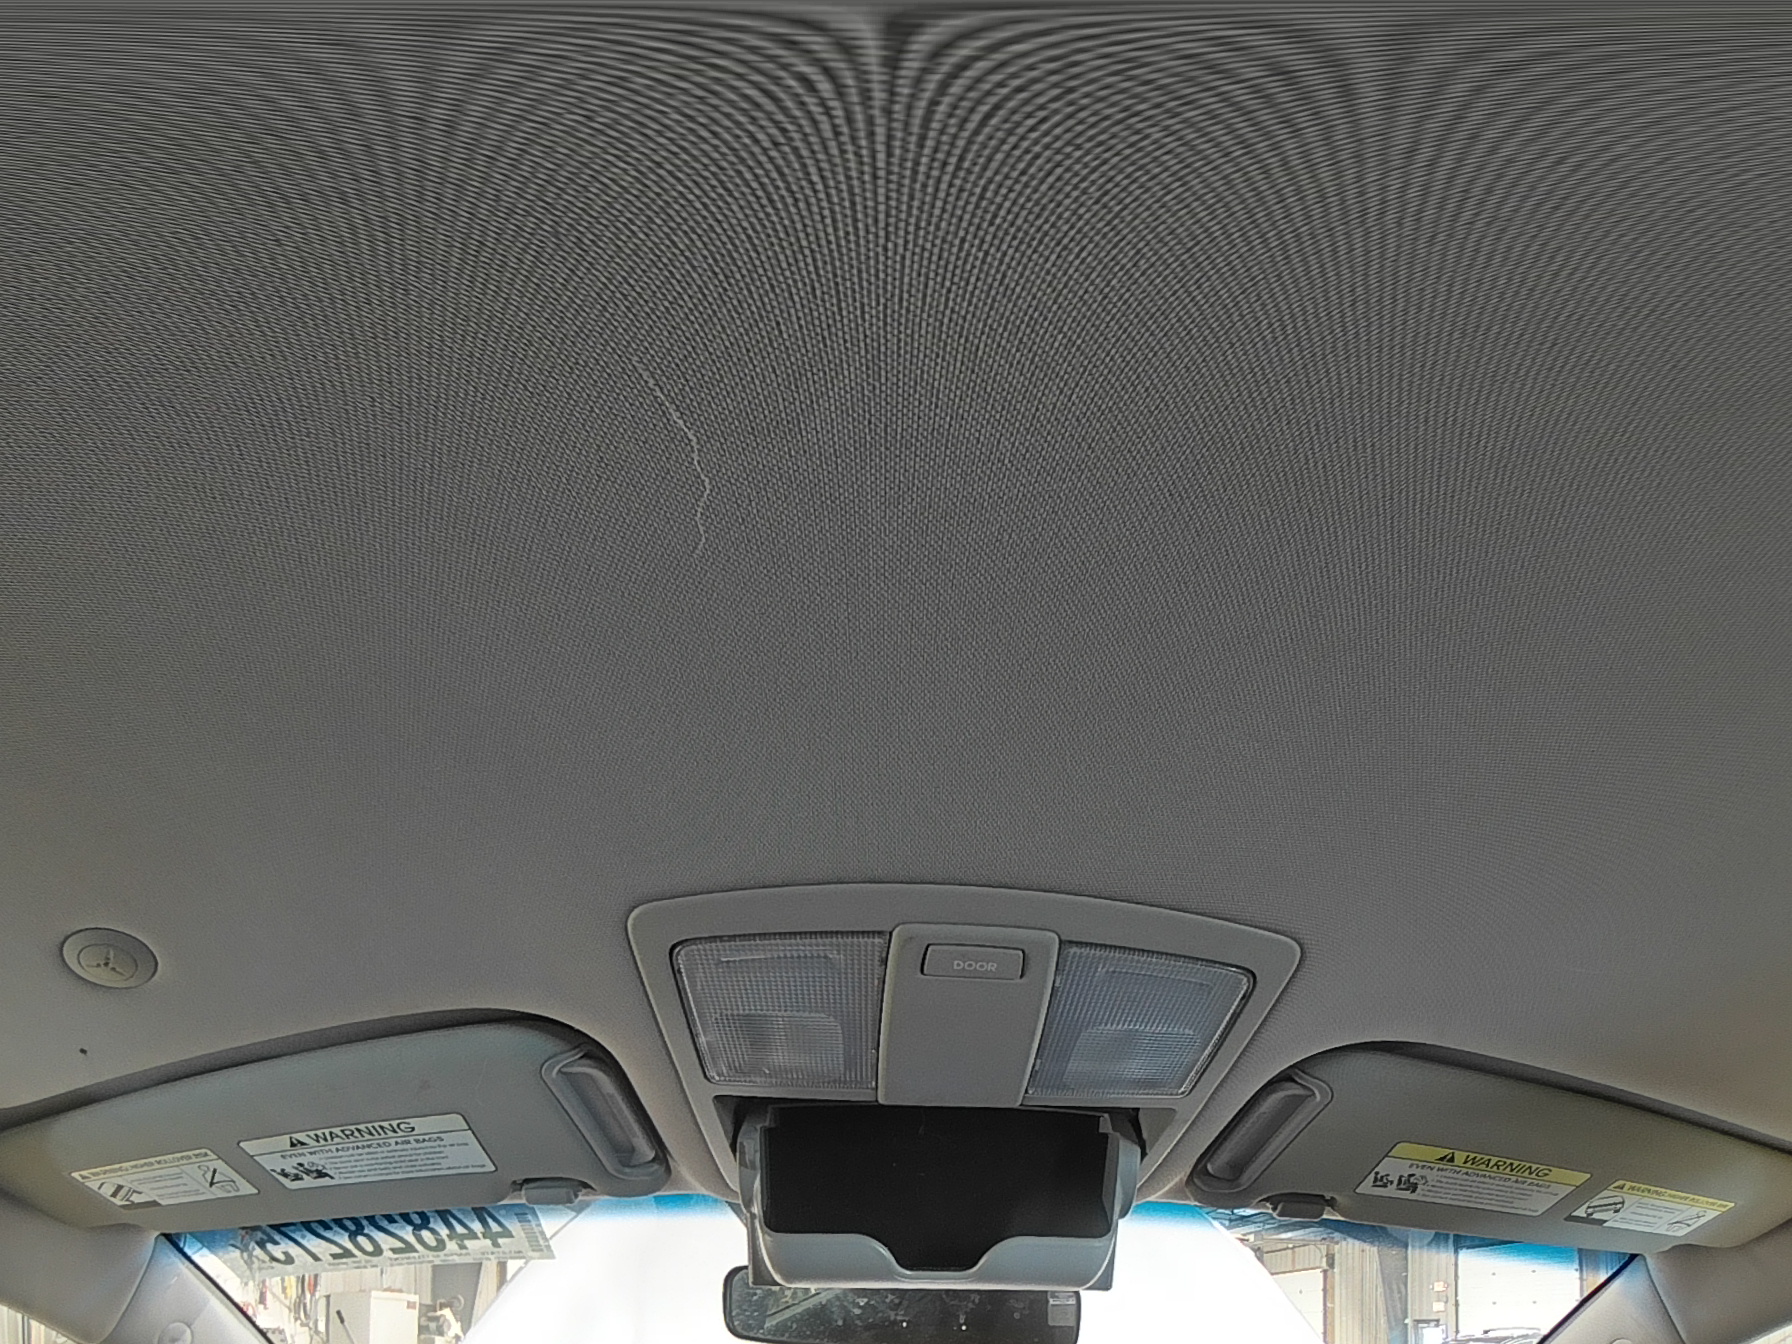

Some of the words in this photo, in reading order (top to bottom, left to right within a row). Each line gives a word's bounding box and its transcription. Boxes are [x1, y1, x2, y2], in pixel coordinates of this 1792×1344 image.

[953, 960, 997, 972] DOOR
[306, 1121, 416, 1144] WARNING
[334, 1141, 392, 1153] ADVANCED
[394, 1139, 412, 1147] AIR
[413, 1135, 444, 1144] BAGS
[1408, 1163, 1436, 1172] EVEN
[1436, 1167, 1462, 1175] WITH
[1461, 1170, 1511, 1183] ADVANCED
[1511, 1177, 1527, 1186] AIR
[1462, 1154, 1553, 1179] WARNING
